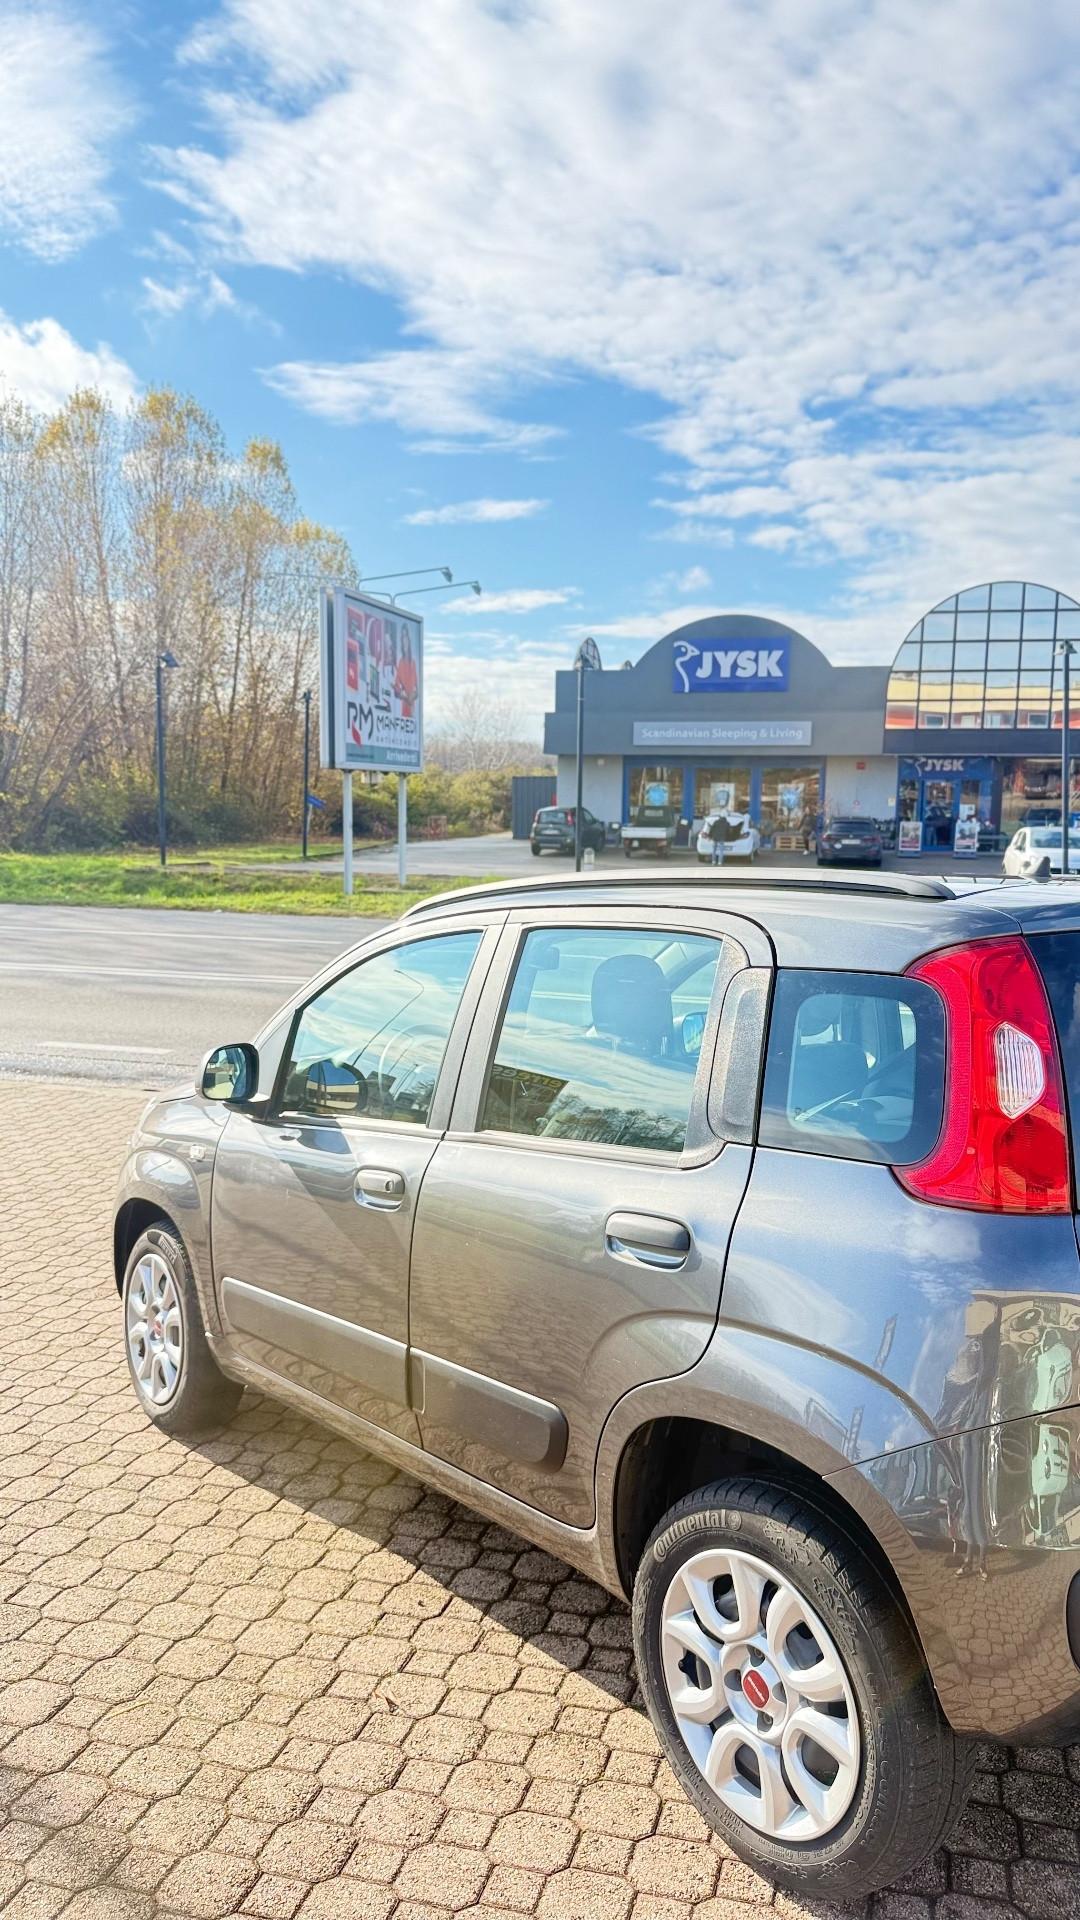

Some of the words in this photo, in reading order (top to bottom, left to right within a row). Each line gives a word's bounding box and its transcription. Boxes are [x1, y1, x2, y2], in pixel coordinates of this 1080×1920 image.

[695, 649, 784, 679] JYSK
[641, 727, 710, 739] Scandinavian
[711, 727, 757, 741] Sleeping
[759, 728, 768, 738] &
[769, 728, 803, 741] Living
[924, 758, 965, 772] JYSK
[653, 1508, 729, 1563] Continental
